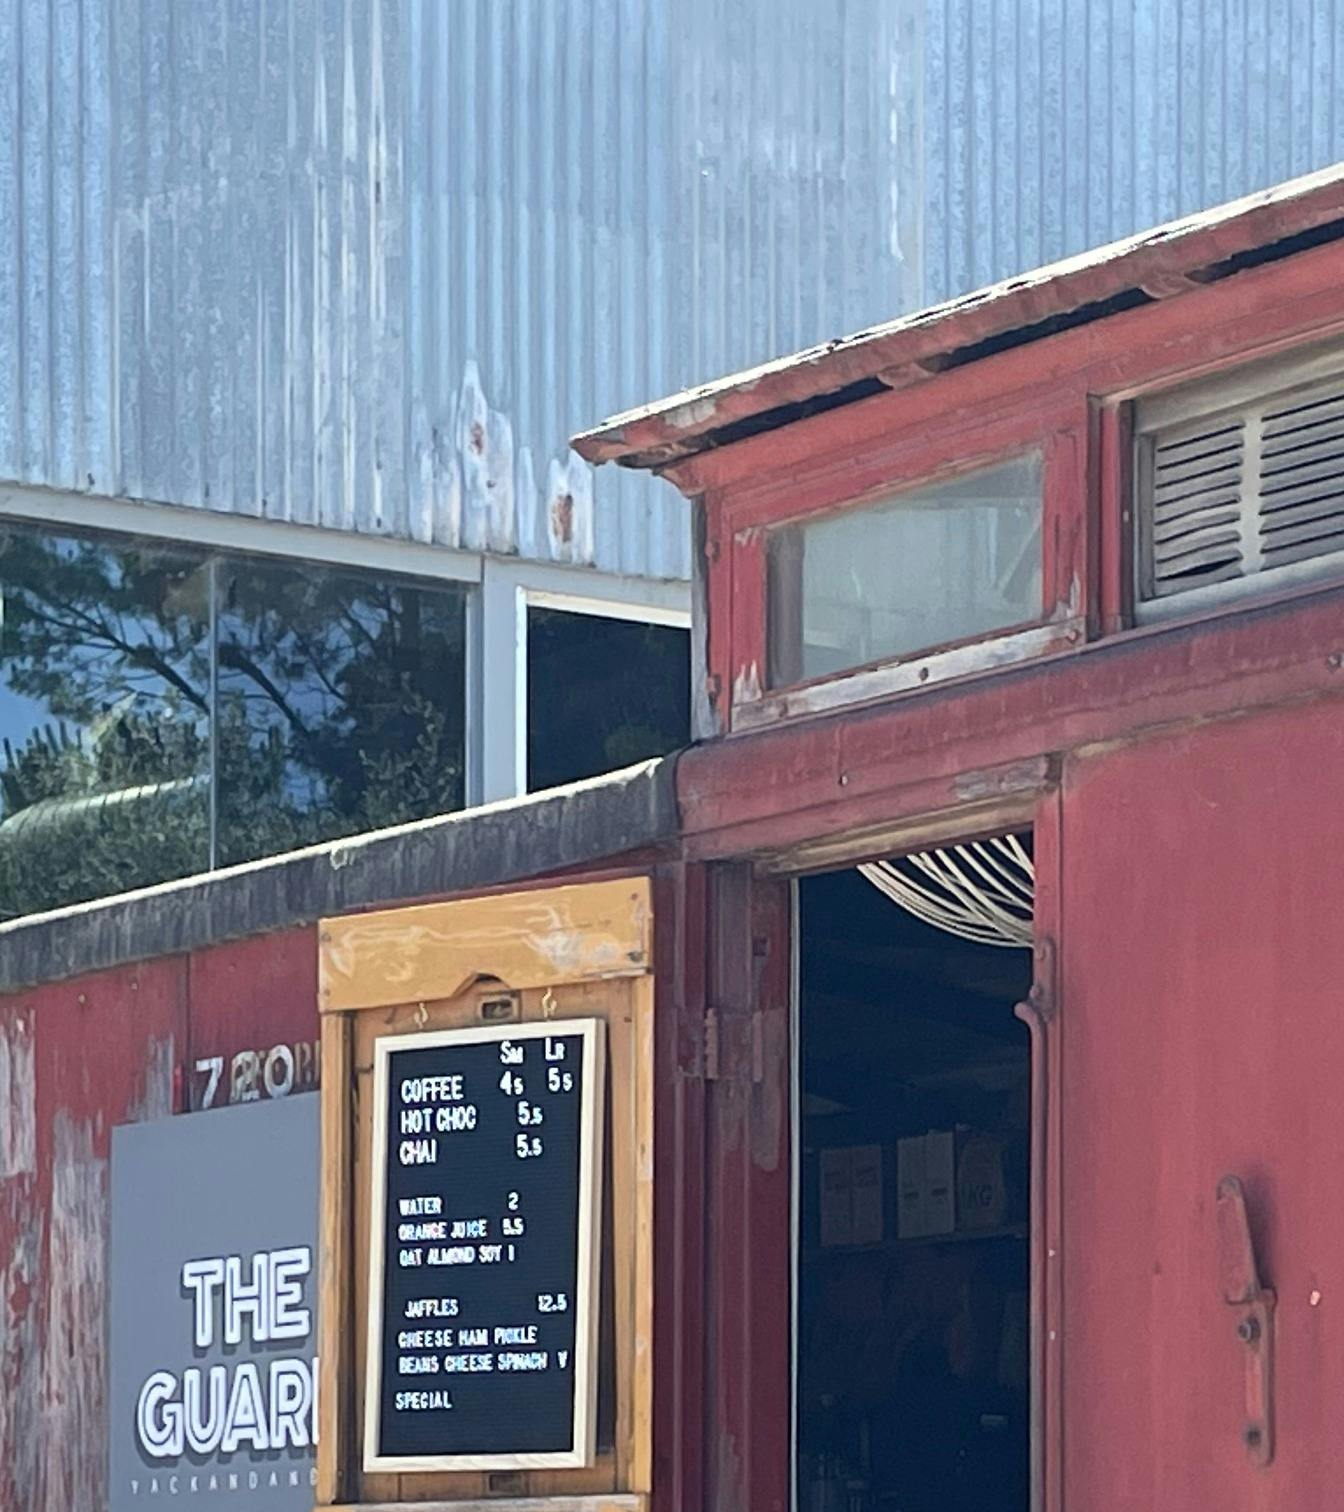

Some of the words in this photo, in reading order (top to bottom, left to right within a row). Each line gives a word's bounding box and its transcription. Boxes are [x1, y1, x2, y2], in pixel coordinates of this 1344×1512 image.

[401, 1074, 464, 1104] COFFEE
[400, 1107, 434, 1134] HOT
[435, 1105, 477, 1132] CHOC
[399, 1138, 437, 1165] CHAI
[399, 1196, 442, 1216] WATER
[508, 1191, 519, 1211] 2
[397, 1221, 448, 1241] ORANGE
[450, 1219, 488, 1239] JUICE
[399, 1248, 423, 1267] OAT
[426, 1246, 476, 1265] ALMOND
[478, 1244, 503, 1263] SOY
[184, 1248, 310, 1347] THE
[404, 1298, 459, 1318] JAFFLES
[398, 1328, 453, 1349] CHEESE
[458, 1328, 489, 1347] HAM
[494, 1325, 538, 1345] PICKLE
[399, 1355, 440, 1374] BEANS
[444, 1353, 494, 1372] CHEESE
[497, 1351, 548, 1371] SPINACH
[395, 1390, 452, 1410] SPECIAL
